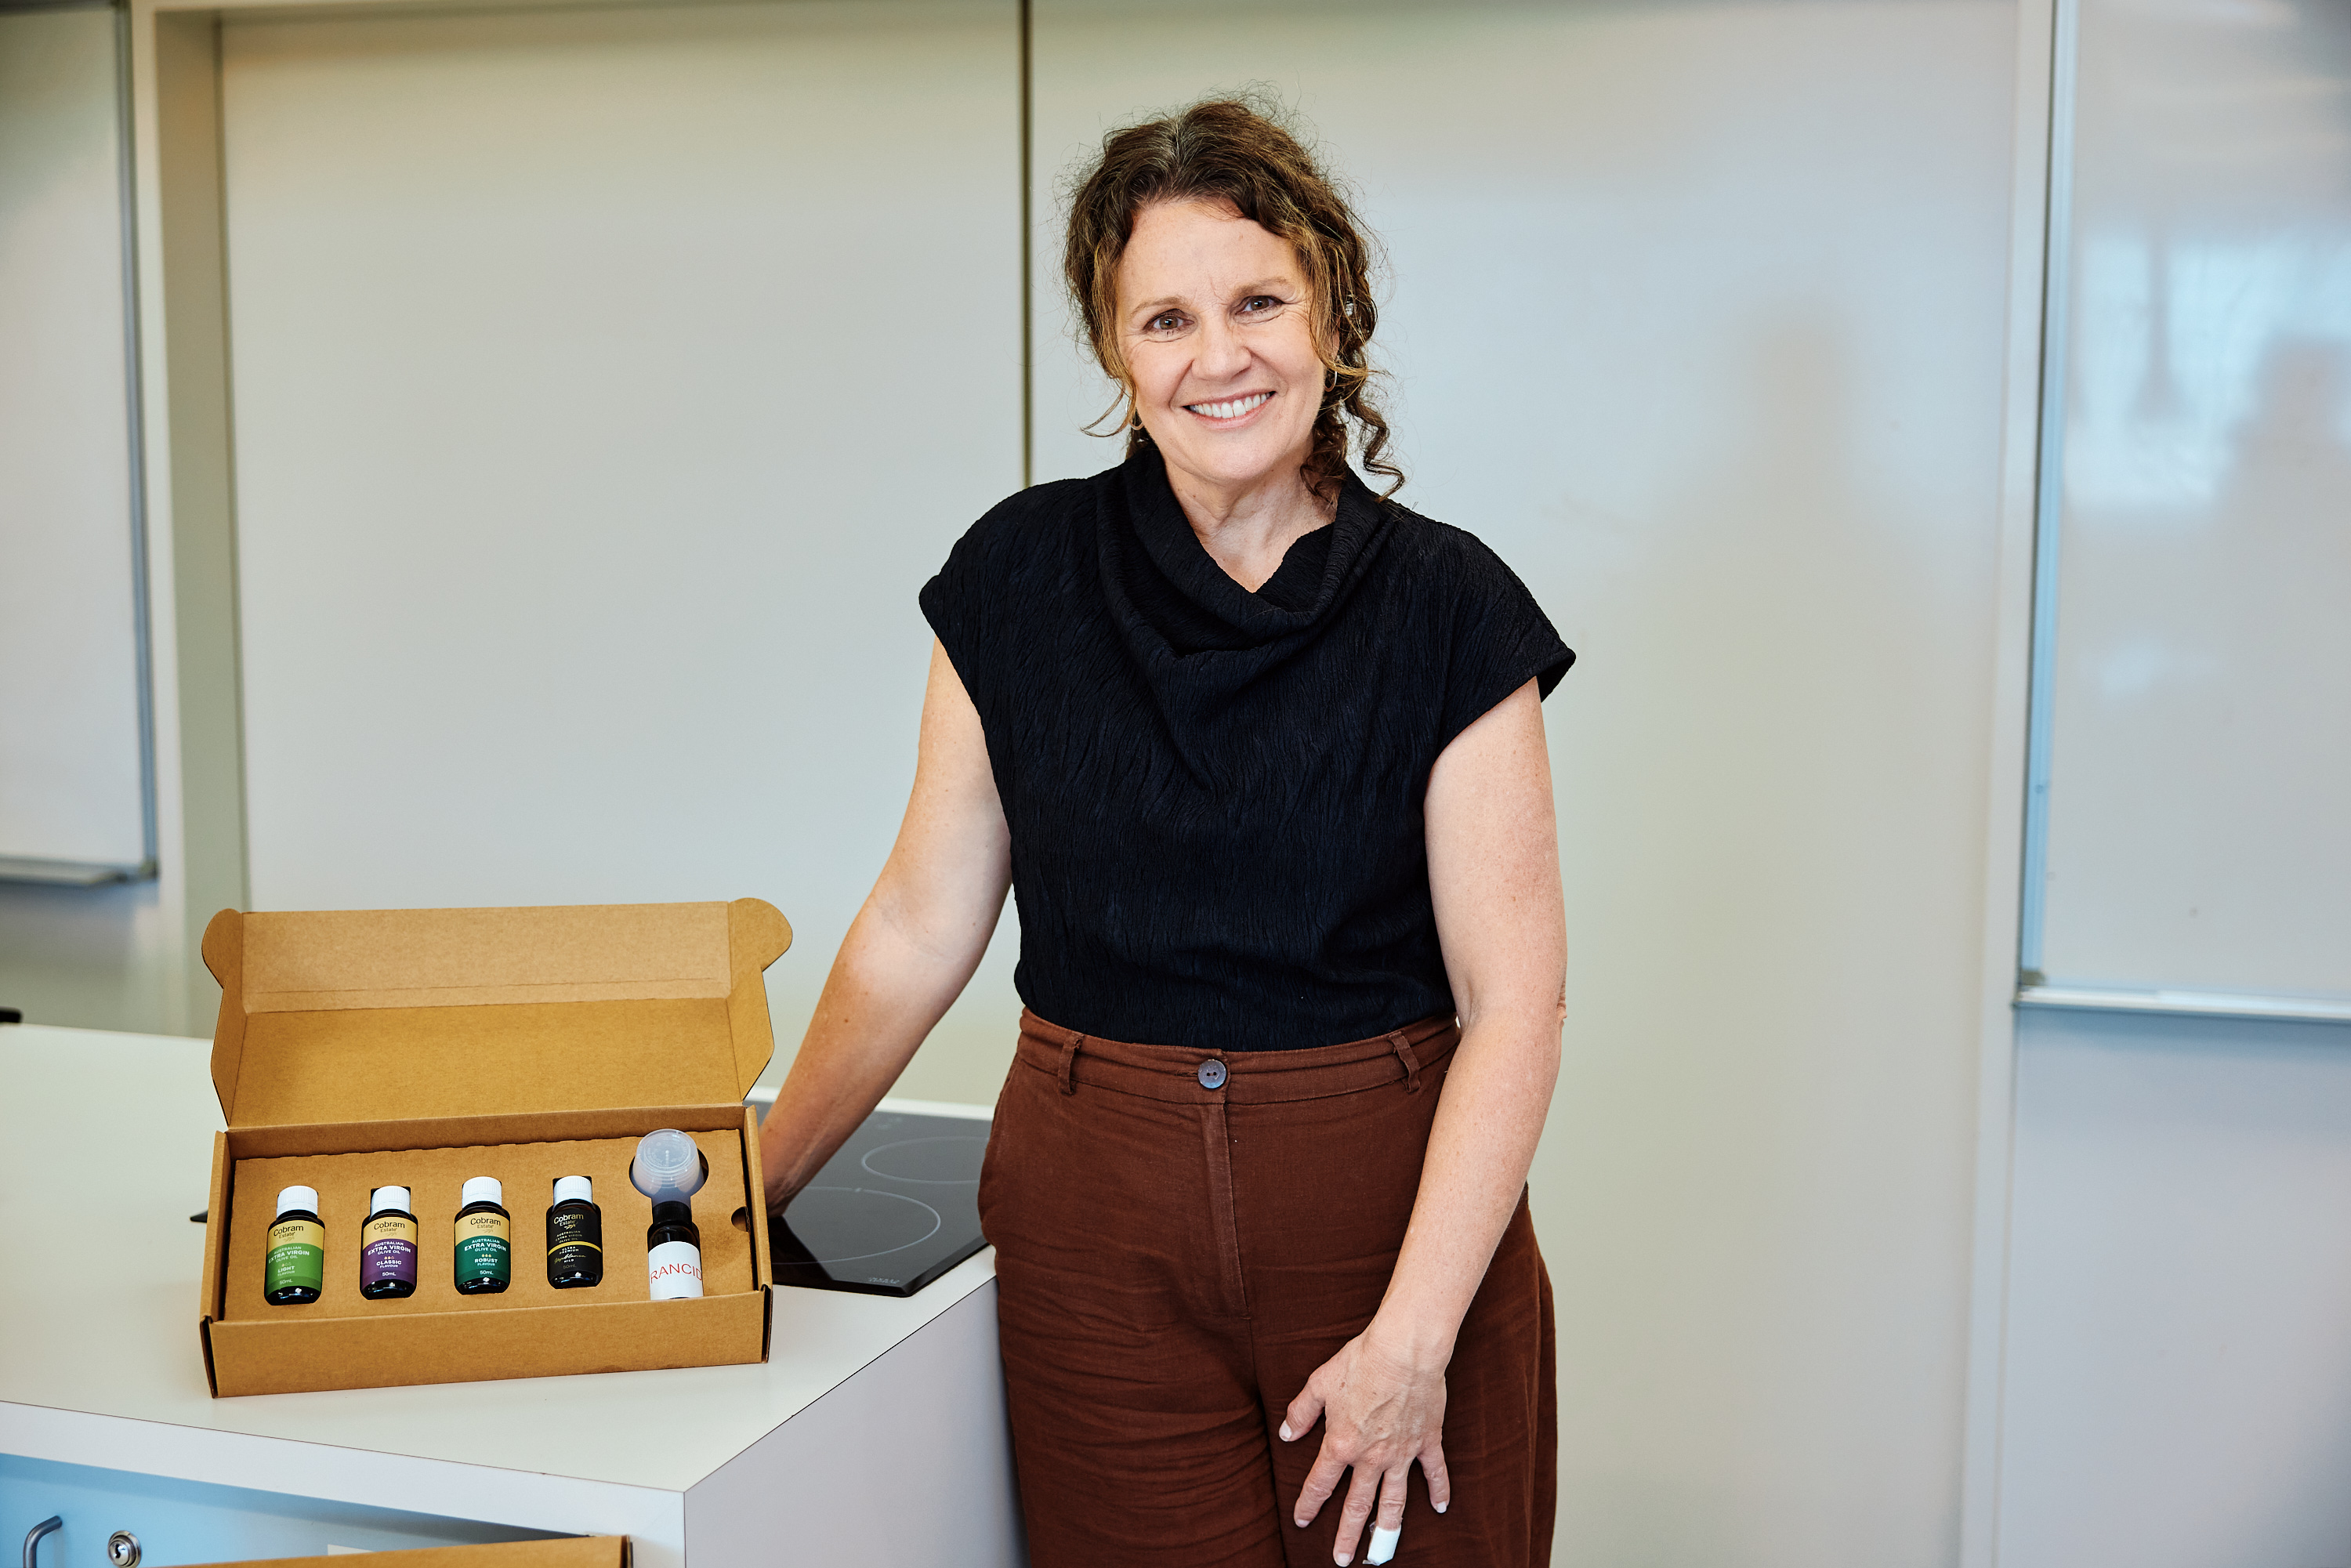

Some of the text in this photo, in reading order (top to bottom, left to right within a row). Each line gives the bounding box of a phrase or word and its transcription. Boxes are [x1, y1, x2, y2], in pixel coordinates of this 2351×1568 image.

[554, 1214, 584, 1224] Cobram
[273, 1226, 303, 1236] Cobram
[368, 1246, 387, 1255] EXTRA
[487, 1243, 506, 1251] VIRGIN
[269, 1252, 285, 1264] EXTRA
[650, 1263, 702, 1284] RANCID
